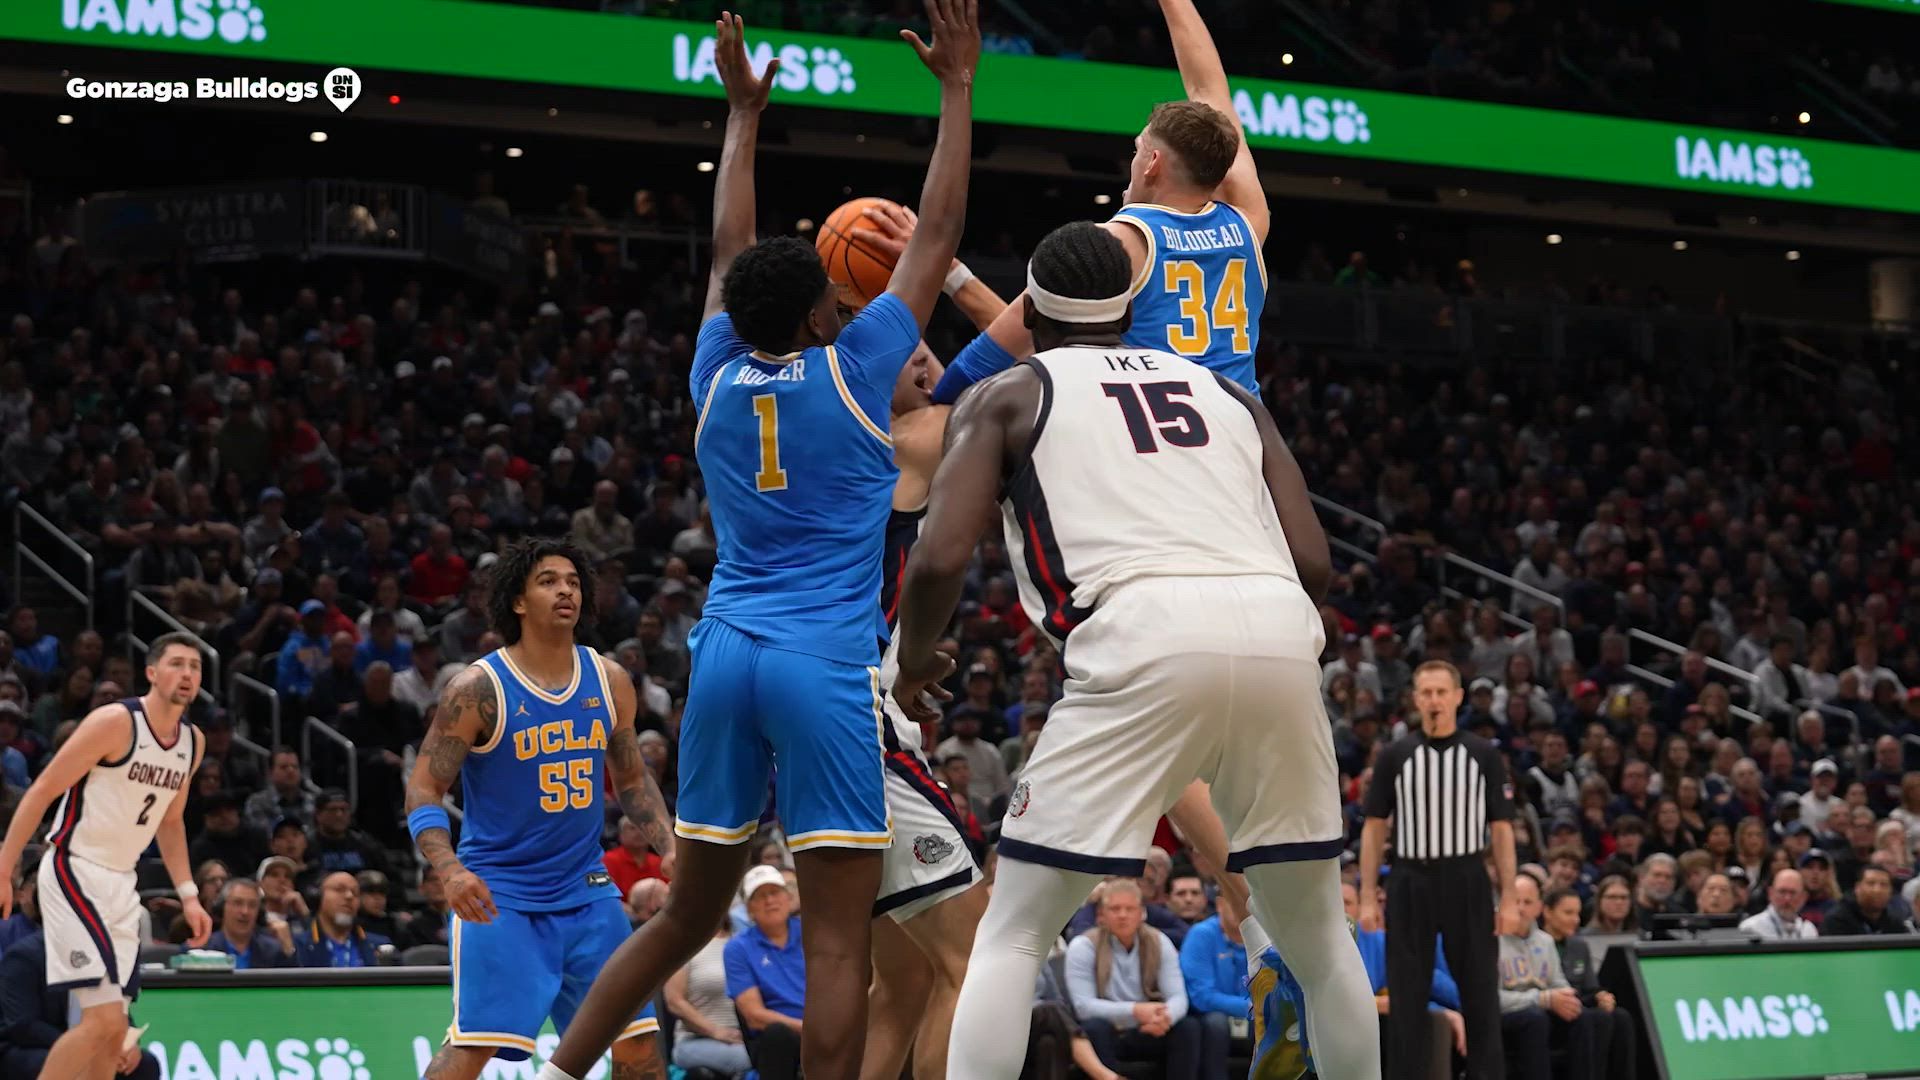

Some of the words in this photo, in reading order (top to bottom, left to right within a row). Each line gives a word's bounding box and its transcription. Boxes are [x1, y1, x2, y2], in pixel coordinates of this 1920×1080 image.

[1233, 88, 1331, 142] AMS
[1675, 135, 1778, 187] IAMS
[184, 217, 256, 246] CLUB
[1161, 223, 1245, 251] BILODEAU
[1163, 258, 1251, 356] 34
[732, 359, 806, 386] BOOER
[1103, 354, 1160, 371] IKE
[1100, 380, 1210, 454] 15
[752, 392, 788, 492] 1
[513, 719, 608, 760] UCLA
[539, 757, 593, 813] 55
[136, 793, 157, 826] 2
[1676, 995, 1791, 1042] IAMS
